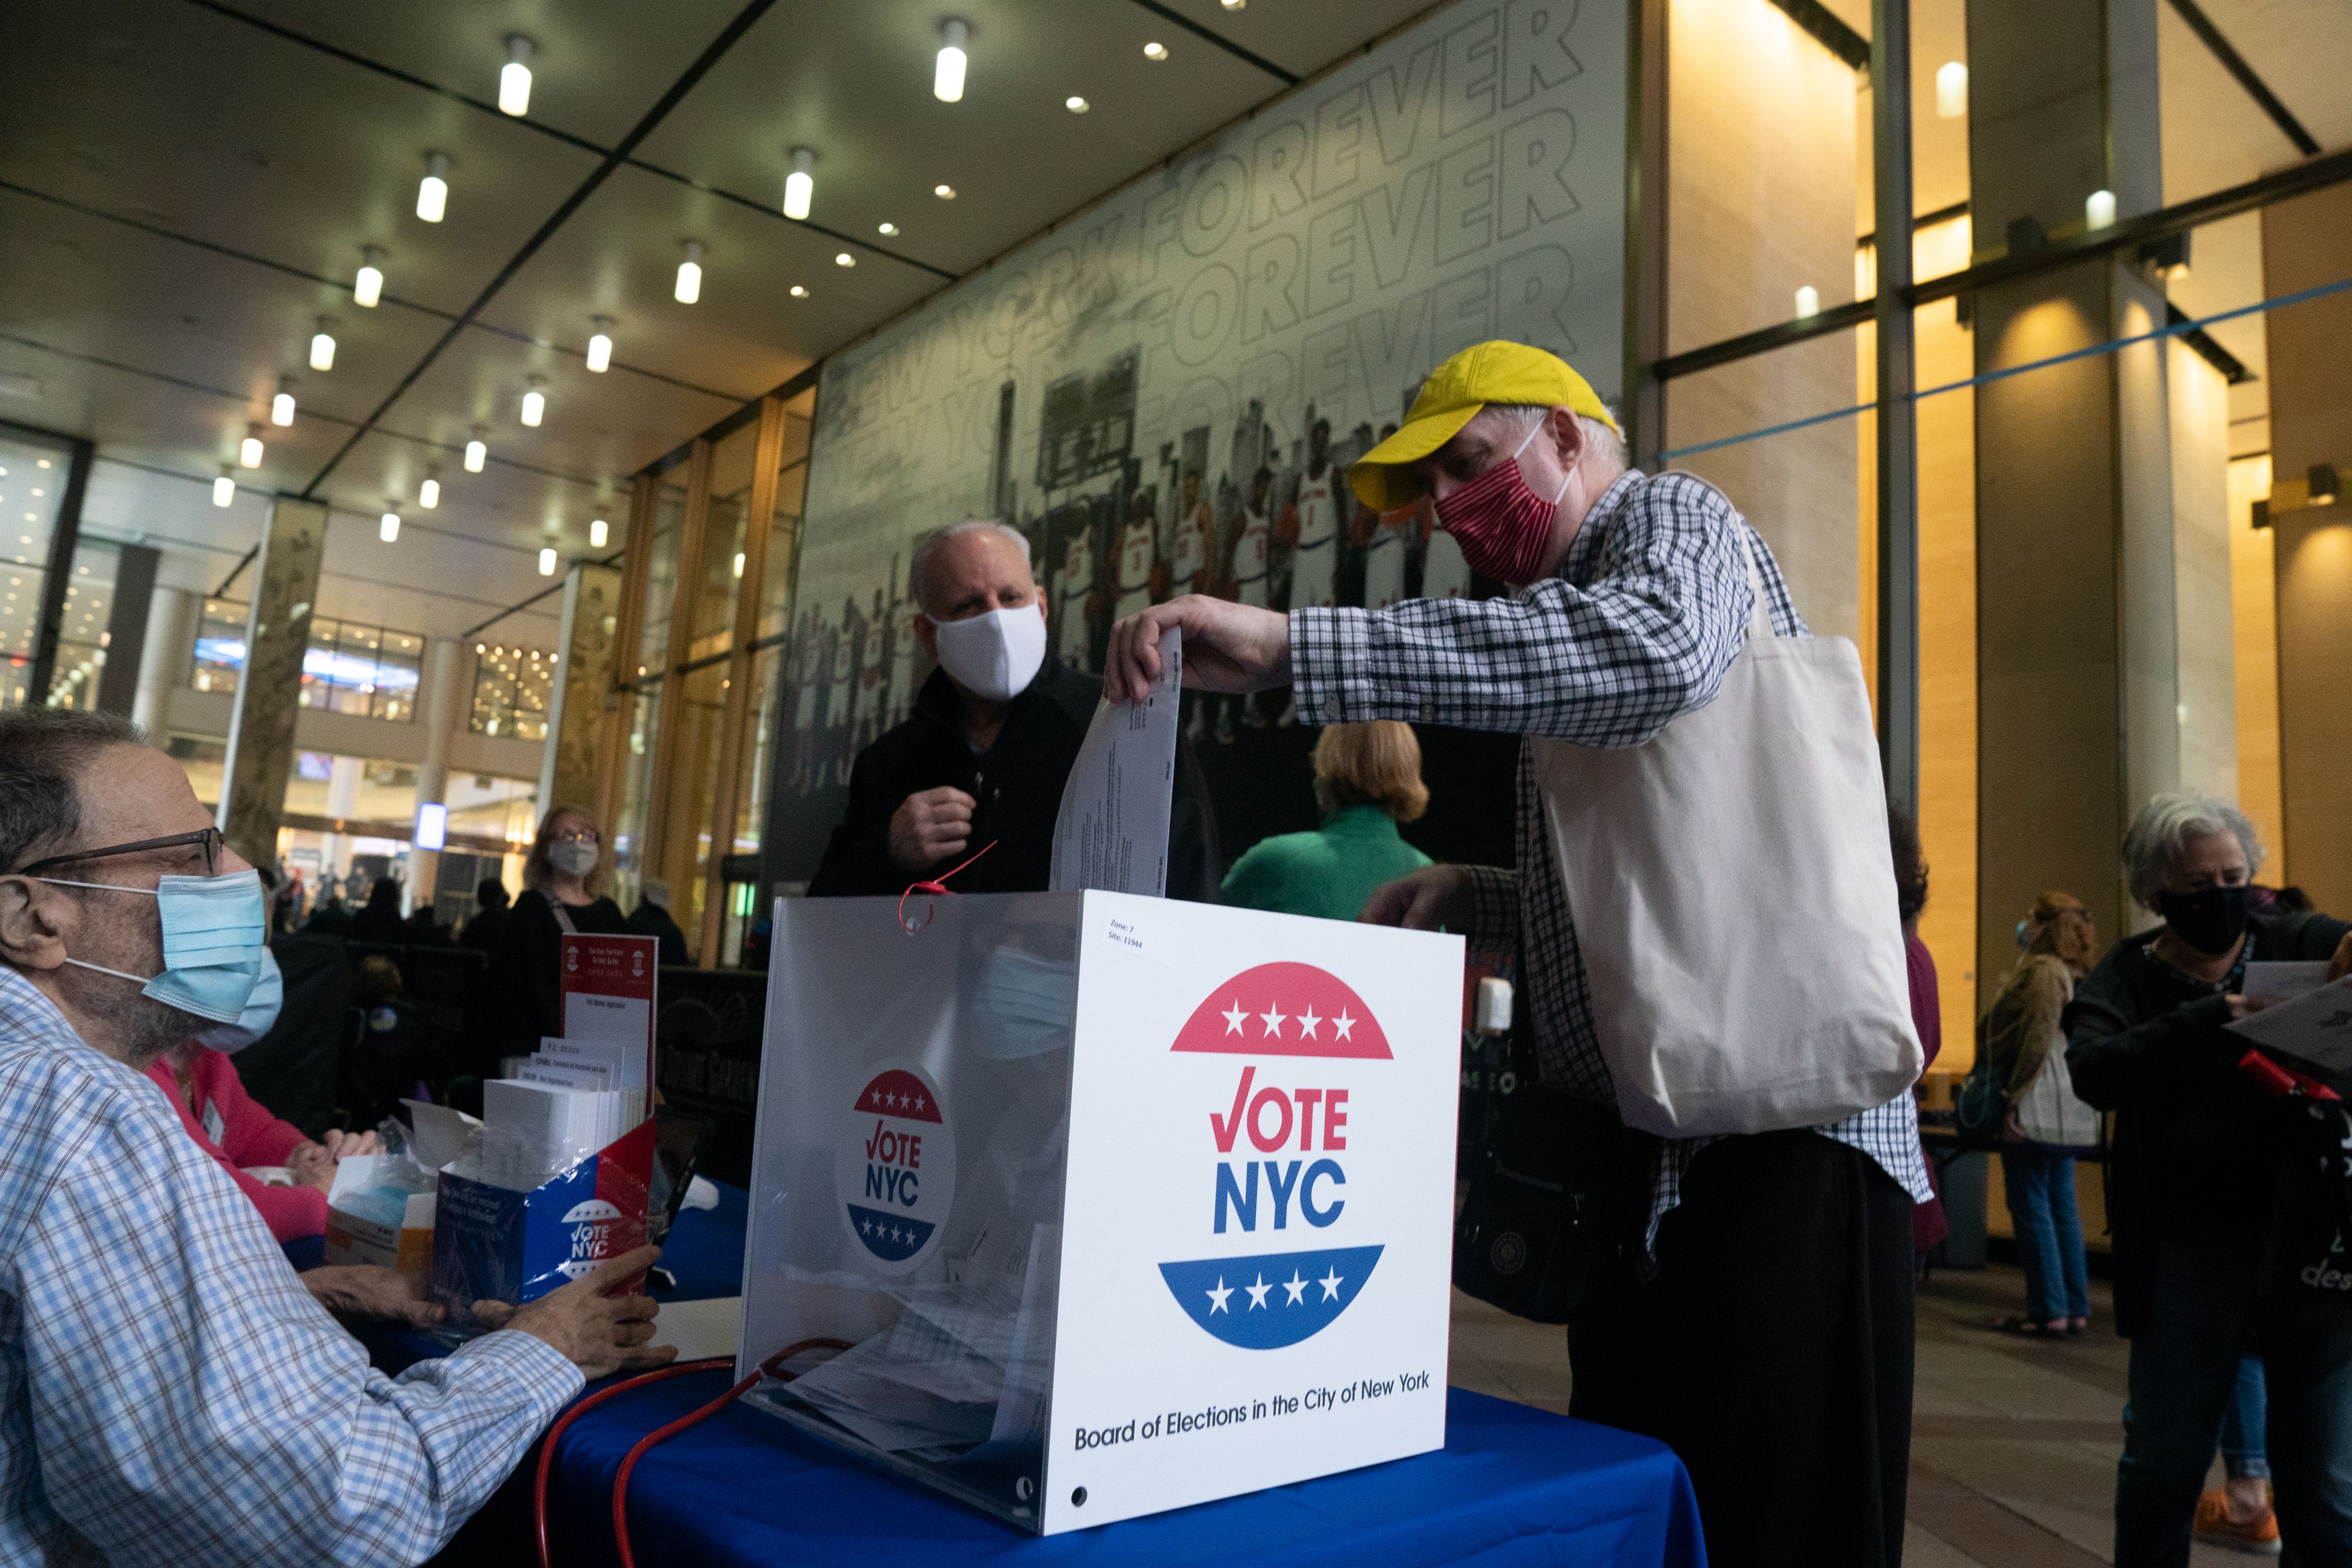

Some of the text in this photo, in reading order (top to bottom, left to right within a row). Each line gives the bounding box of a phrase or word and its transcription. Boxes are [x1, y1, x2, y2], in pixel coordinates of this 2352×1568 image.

[1137, 0, 1585, 287] FOREVER
[1129, 107, 1581, 390] FOREVER
[1108, 931, 1142, 949] Site: 11944
[1111, 918, 1128, 932] Zone:
[1210, 1066, 1348, 1153] VOTE
[866, 1119, 921, 1169] VOTE
[865, 1164, 919, 1207] NYC
[1213, 1158, 1347, 1235] NYC
[571, 1222, 610, 1243] VOTE
[572, 1240, 608, 1259] NYC
[1075, 1370, 1429, 1450] Board of Elections in the City of New York
